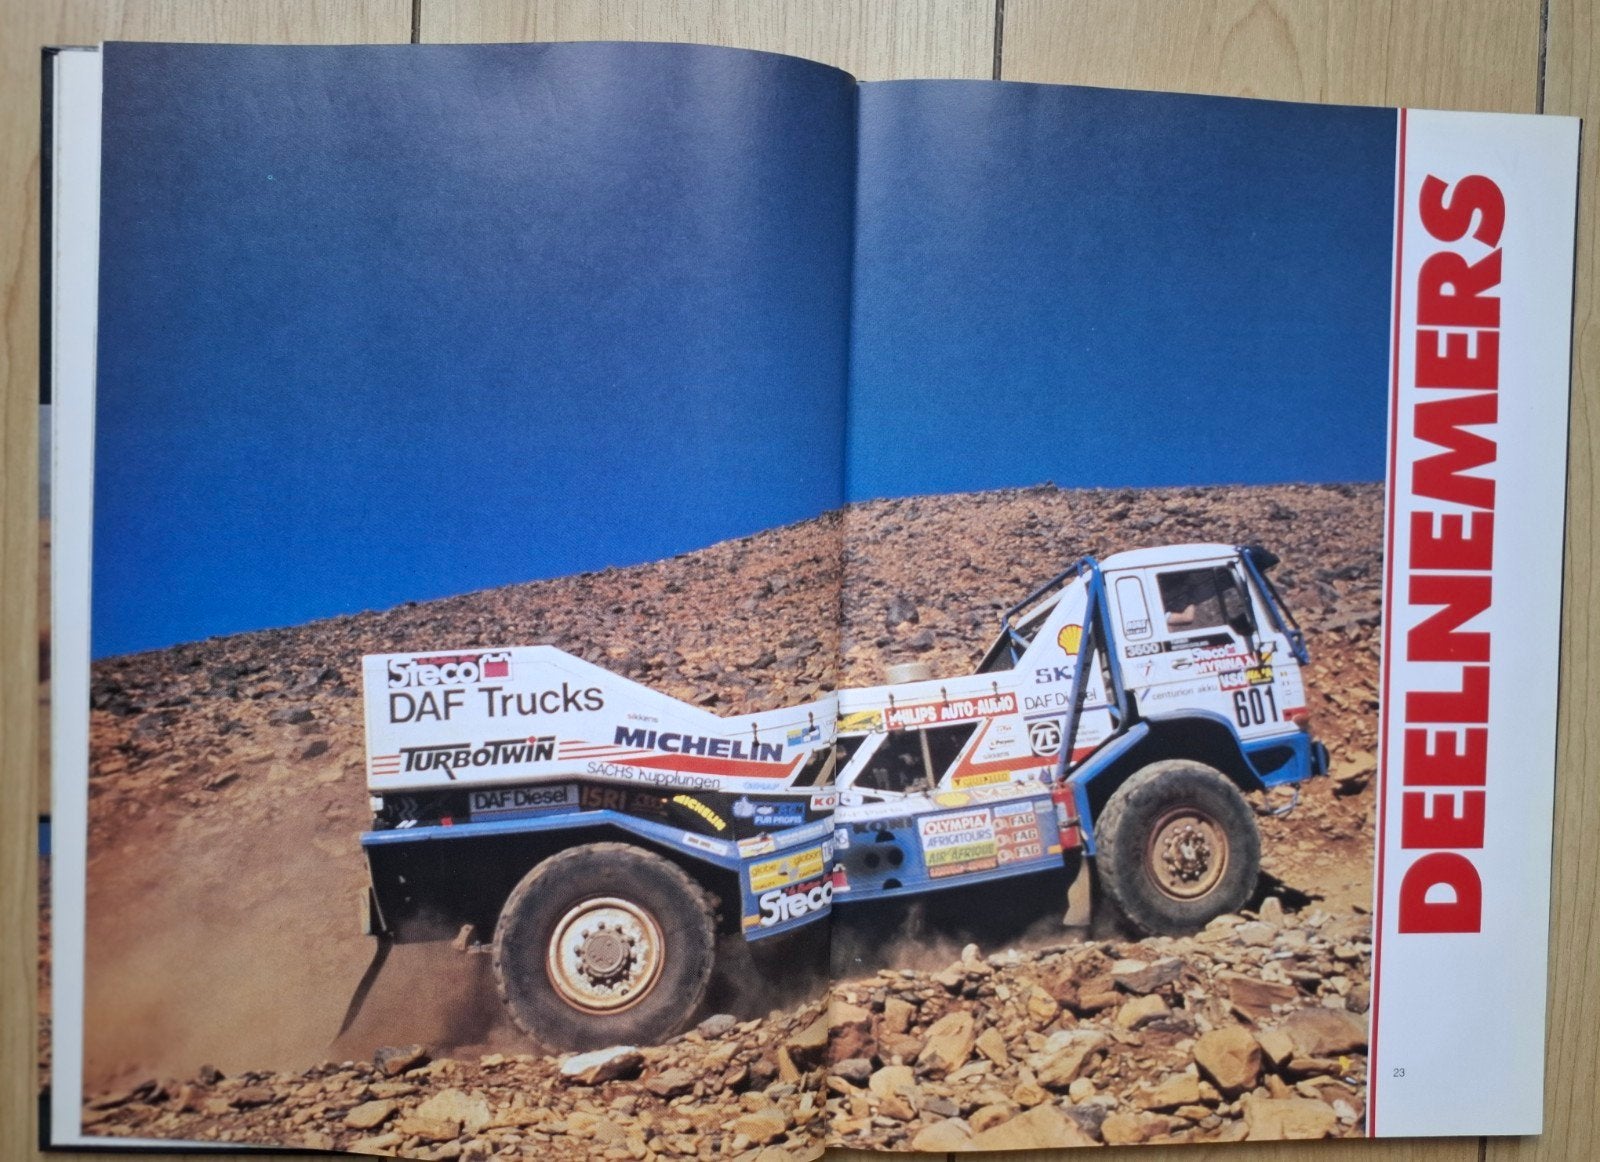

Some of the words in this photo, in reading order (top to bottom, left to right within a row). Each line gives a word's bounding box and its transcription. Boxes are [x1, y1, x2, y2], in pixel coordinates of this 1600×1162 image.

[1398, 174, 1505, 933] DEELNEMERS
[389, 658, 480, 688] Steco
[1036, 666, 1075, 684] SK
[389, 689, 465, 724] DAF
[478, 682, 604, 718] Trucks
[1025, 693, 1052, 710] DAF
[1233, 685, 1278, 728] 601
[890, 706, 937, 726] PHILIPS
[614, 726, 783, 763] MICHELIN
[1031, 726, 1061, 750] ZF
[587, 761, 634, 779] SACHS
[474, 792, 512, 809] DAF
[513, 788, 568, 806] Diesel
[926, 814, 984, 834] OLYMPIA
[1011, 814, 1034, 828] FAG
[1014, 830, 1037, 843] FAG
[1016, 845, 1040, 858] FAG
[760, 881, 833, 926] Steco
[1393, 1067, 1405, 1078] 23
